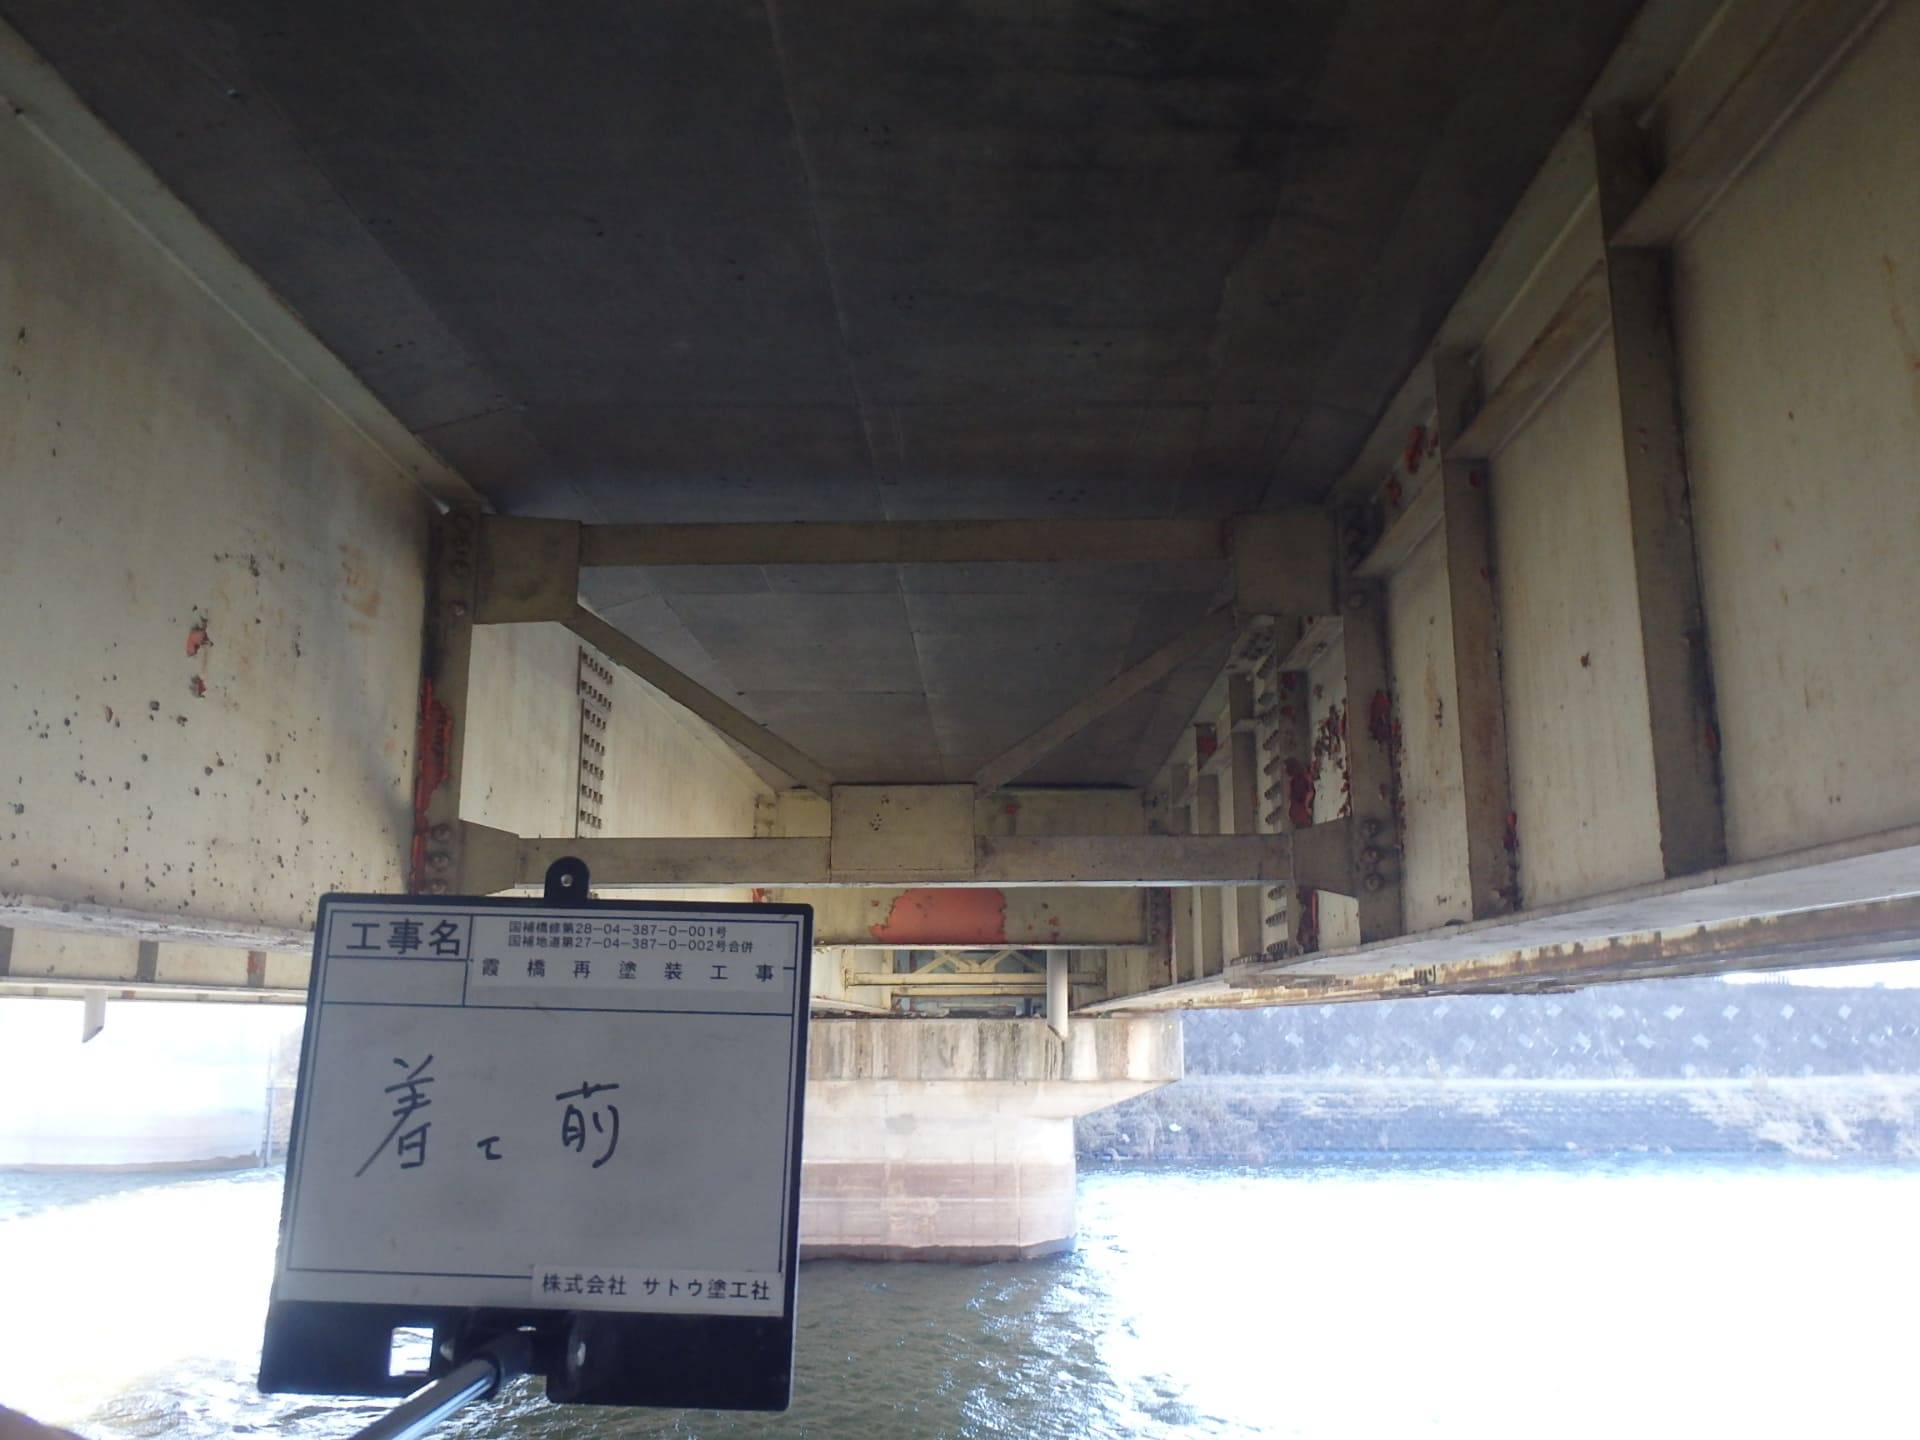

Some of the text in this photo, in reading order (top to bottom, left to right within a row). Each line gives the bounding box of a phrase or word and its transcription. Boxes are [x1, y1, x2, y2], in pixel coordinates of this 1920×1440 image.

[345, 919, 461, 956] 工事名
[542, 1273, 770, 1300] 株式会社 サトウ塗工社
